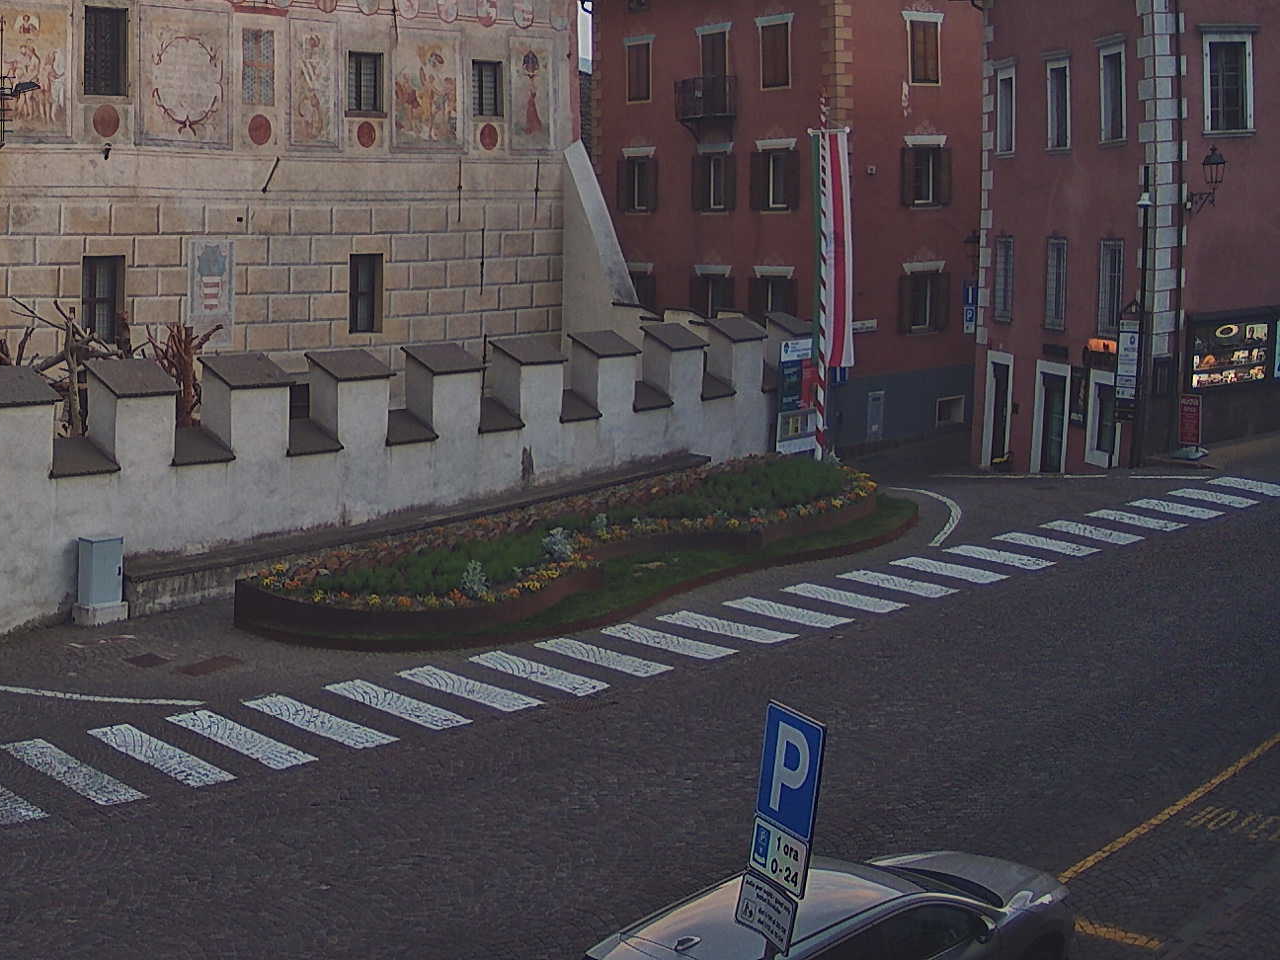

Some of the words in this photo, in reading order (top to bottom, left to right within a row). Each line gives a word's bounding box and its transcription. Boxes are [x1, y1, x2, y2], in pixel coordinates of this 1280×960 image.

[770, 720, 810, 813] P
[776, 836, 783, 851] 1
[783, 846, 800, 862] ora
[770, 858, 799, 888] 0-24
